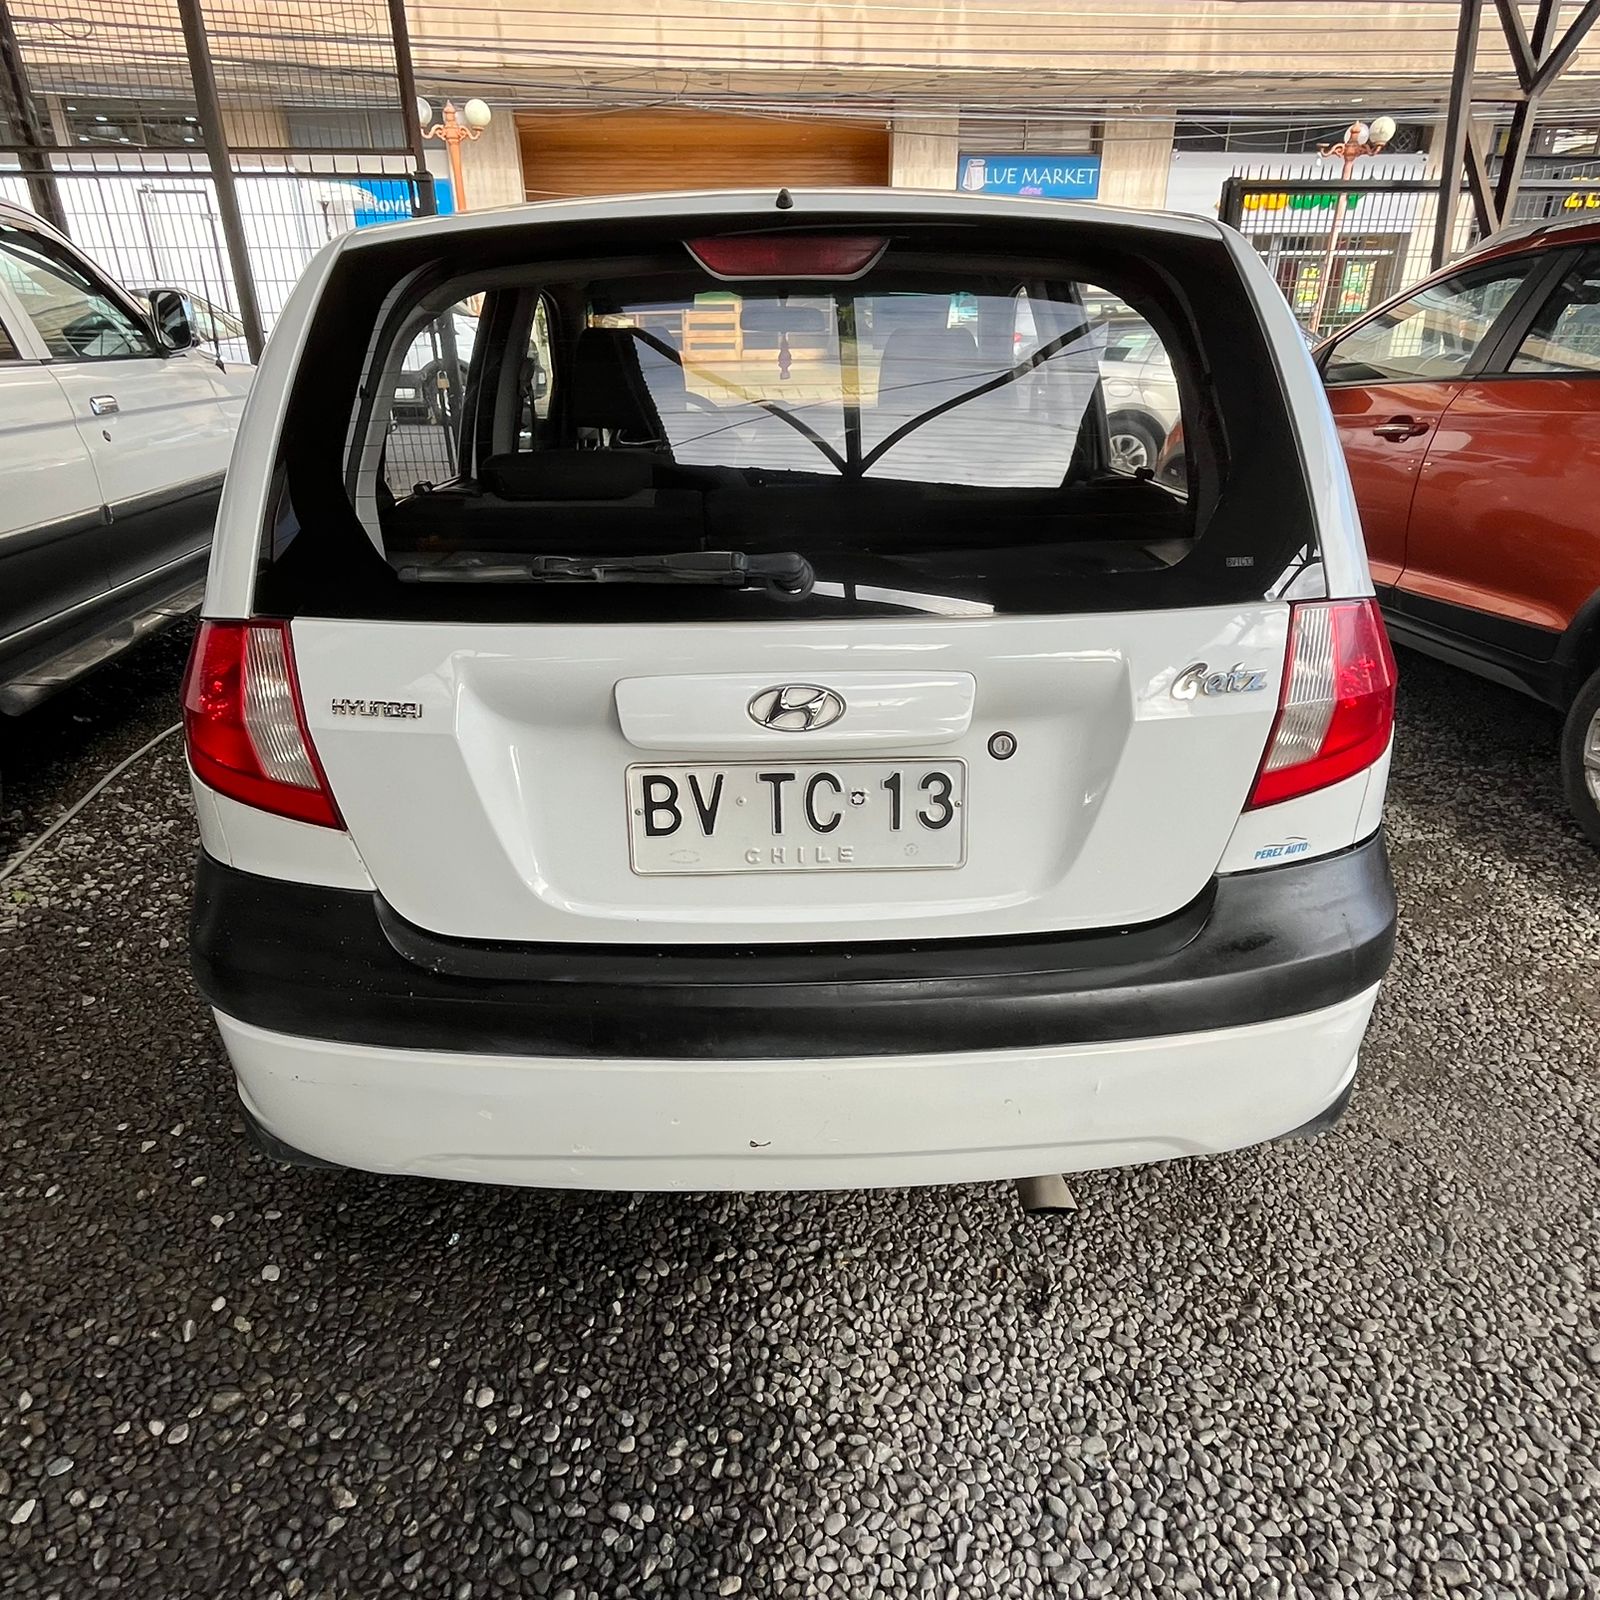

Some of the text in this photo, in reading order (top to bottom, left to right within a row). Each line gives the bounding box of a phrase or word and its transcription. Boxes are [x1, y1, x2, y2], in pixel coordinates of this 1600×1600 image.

[1021, 167, 1098, 185] MARKET
[1171, 661, 1267, 700] Getz
[331, 698, 423, 719] HYUNDAI
[642, 771, 954, 837] BV TC 13
[745, 846, 854, 864] CHILE
[1254, 842, 1308, 860] PEREZ AUTO
